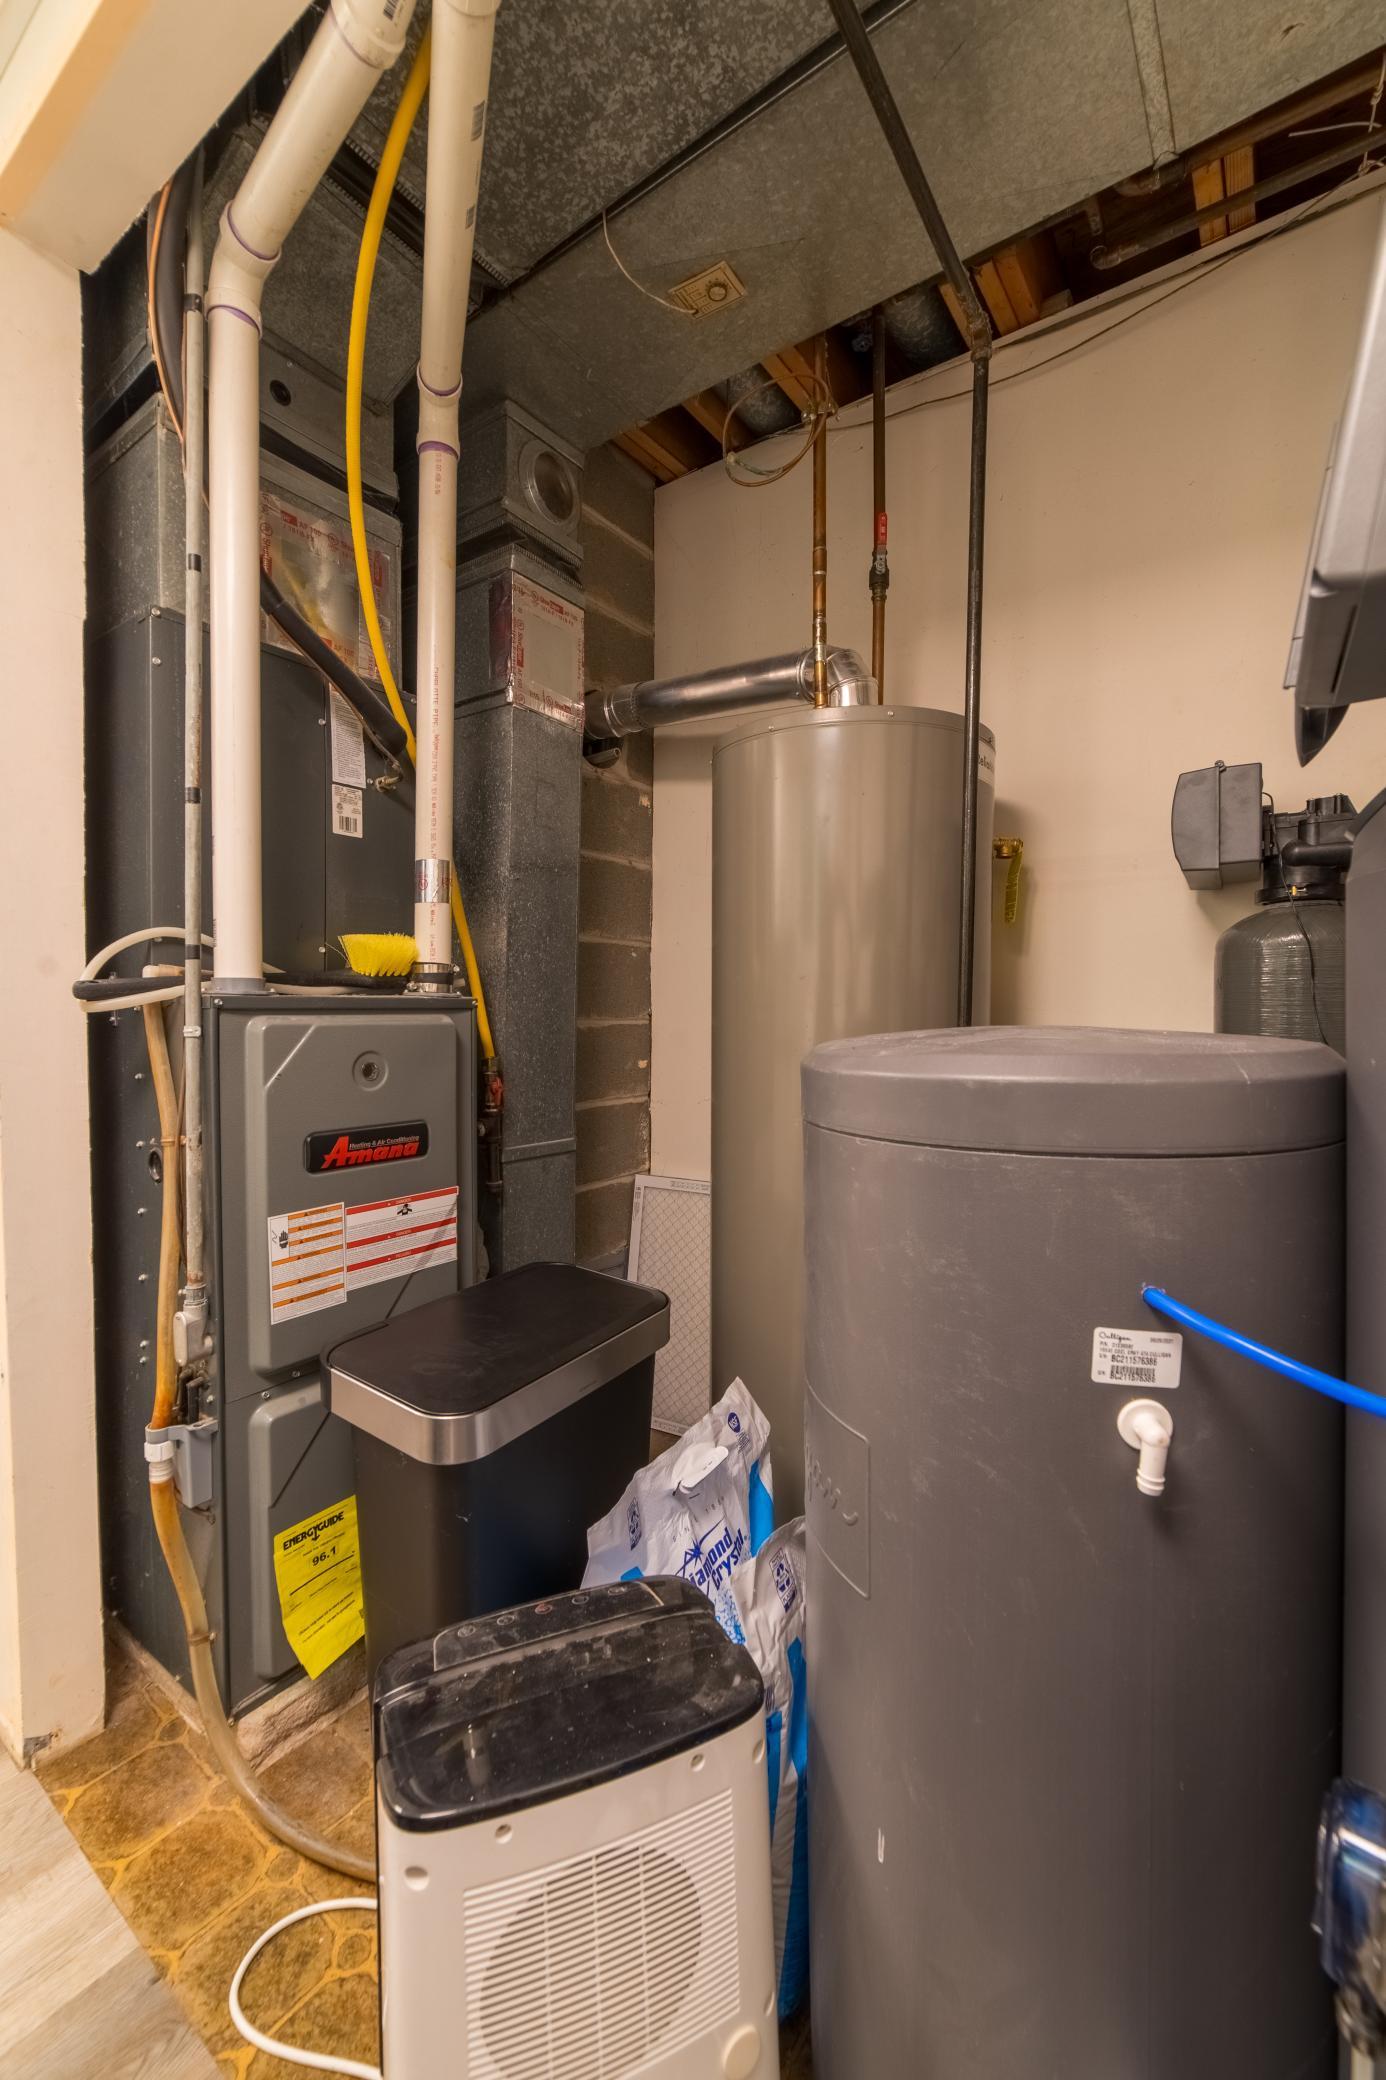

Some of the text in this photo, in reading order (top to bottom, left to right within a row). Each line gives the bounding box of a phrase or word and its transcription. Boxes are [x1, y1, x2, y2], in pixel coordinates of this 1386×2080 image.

[320, 1135, 420, 1169] Amana
[349, 1141, 371, 1151] Heating
[386, 1135, 420, 1146] Conditioning
[1099, 1331, 1132, 1343] Culligan
[283, 1511, 345, 1551] ENERGYGUIDE
[312, 1546, 337, 1567] 96.1
[711, 1528, 745, 1591] Crystal
